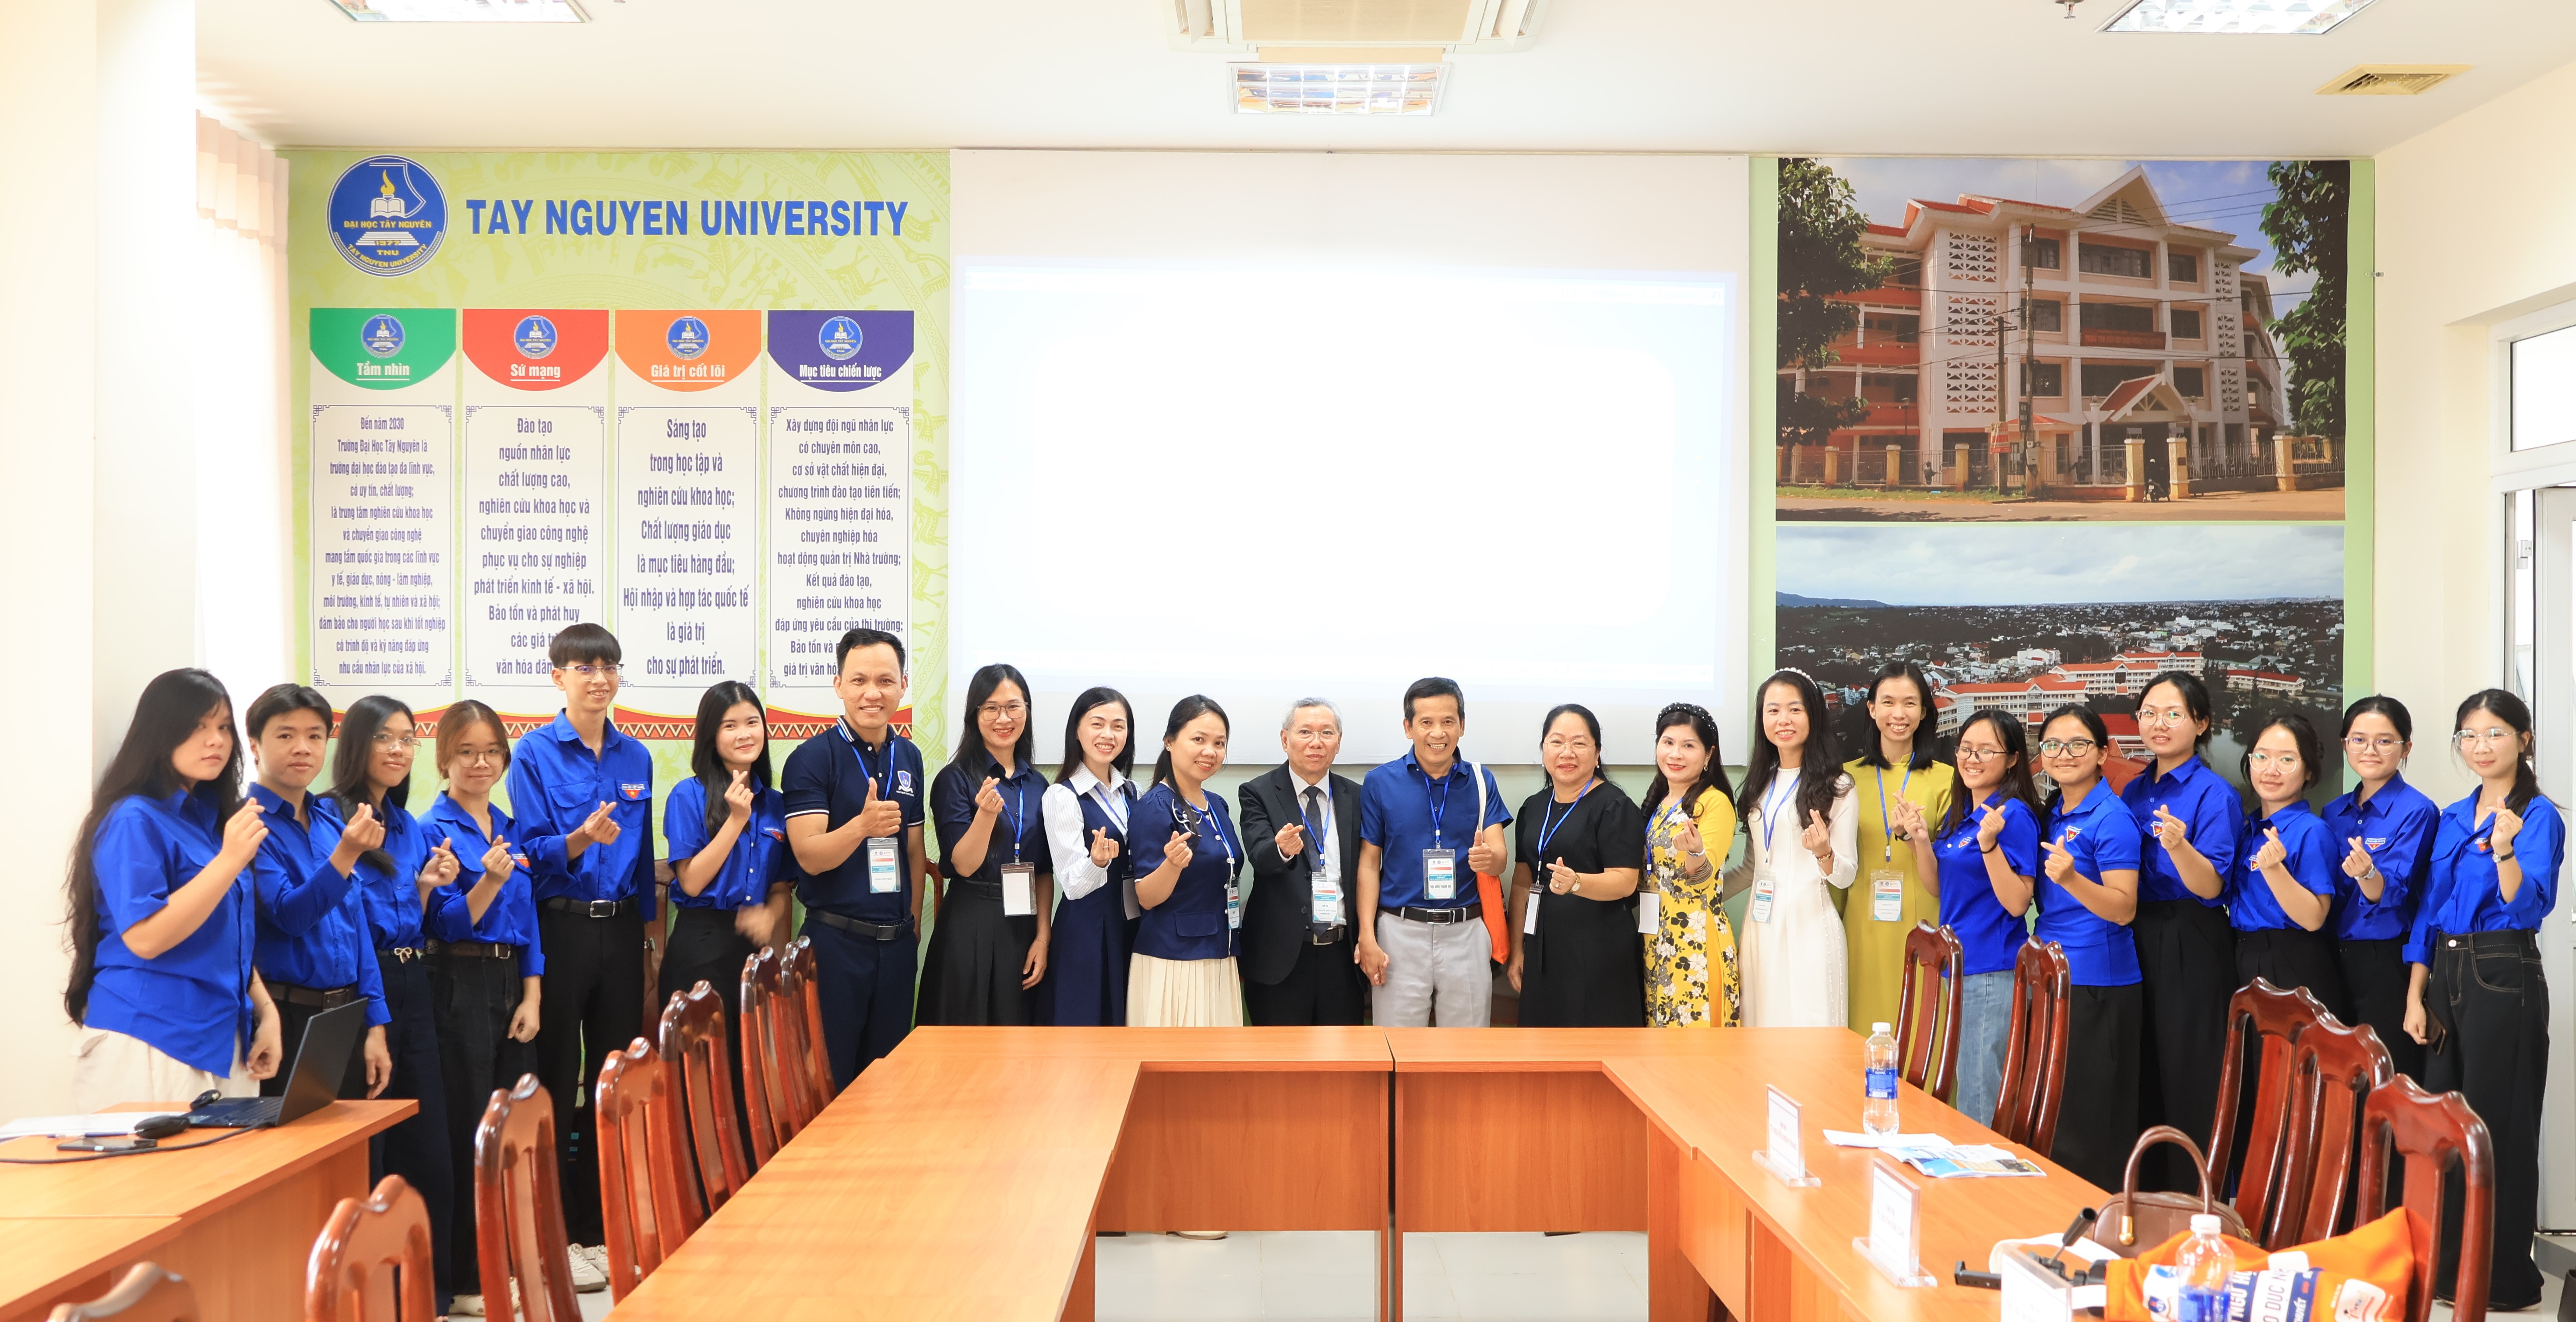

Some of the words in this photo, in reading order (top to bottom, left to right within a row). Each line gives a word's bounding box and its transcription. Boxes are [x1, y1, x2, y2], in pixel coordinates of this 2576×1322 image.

[344, 221, 358, 229] ĐẠI
[360, 221, 377, 229] HỌC
[380, 219, 396, 228] TÂY
[398, 219, 432, 228] NGUYÊN
[467, 200, 532, 234] TAY
[547, 200, 687, 235] NGUYEN
[702, 200, 907, 236] UNIVERSITY
[347, 244, 360, 257] TAY
[359, 255, 388, 267] NGUYEN
[390, 244, 428, 267] UNIVERSITY
[357, 361, 381, 376] Tầm
[384, 362, 410, 376] nhìn
[510, 364, 526, 376] Sứ
[529, 366, 561, 379] mạng
[651, 364, 670, 377] Giá
[673, 365, 685, 380] trị
[689, 362, 708, 377] cốt
[710, 365, 725, 377] lõi
[799, 364, 818, 380] Mục
[820, 364, 836, 377] tiêu
[838, 362, 861, 377] chiến
[863, 365, 882, 380] lược
[360, 415, 372, 429] Đến
[374, 417, 387, 429] năm
[389, 417, 404, 430] 2030
[517, 418, 535, 433] Đào
[538, 419, 552, 436] tạo
[667, 418, 689, 440] Sáng
[692, 420, 706, 442] tạo
[786, 418, 801, 433] Xây
[804, 419, 823, 434] dựng
[826, 418, 838, 434] đội
[841, 419, 856, 433] ngũ
[859, 418, 878, 432] nhân
[881, 419, 893, 434] lực
[499, 443, 527, 461] nguồn
[531, 445, 553, 460] nhân
[556, 445, 570, 463] lực
[799, 441, 808, 454] có
[811, 441, 840, 455] chuyên
[843, 441, 860, 454] môn
[863, 443, 880, 455] cao,
[650, 454, 673, 474] trong
[676, 453, 692, 476] học
[695, 452, 709, 476] tập
[712, 452, 722, 471] và
[793, 465, 802, 475] cơ
[805, 461, 814, 475] sở
[817, 463, 829, 478] vật
[832, 461, 849, 476] chất
[852, 463, 869, 478] hiện
[872, 463, 887, 478] đại,
[499, 468, 519, 486] chất
[522, 471, 547, 490] lượng
[551, 475, 570, 489] cao,
[479, 498, 510, 515] nghiên
[514, 498, 530, 513] cứu
[534, 499, 556, 513] khoa
[559, 499, 576, 517] học
[579, 498, 589, 513] và
[638, 486, 668, 508] nghiên
[671, 486, 687, 505] cứu
[691, 487, 712, 506] khoa
[715, 487, 734, 510] học;
[786, 507, 811, 521] Không
[814, 507, 838, 521] ngừng
[841, 507, 858, 523] hiện
[861, 508, 873, 523] đại
[876, 507, 893, 522] hóa,
[481, 521, 514, 542] chuyển
[517, 525, 537, 542] giao
[540, 525, 562, 542] công
[566, 525, 588, 544] nghệ
[641, 517, 662, 539] Chất
[665, 520, 689, 543] lượng
[692, 520, 711, 541] giáo
[715, 520, 730, 544] dục
[801, 529, 830, 544] chuyên
[833, 530, 860, 545] nghiệp
[863, 530, 877, 542] hóa
[483, 552, 505, 570] phục
[508, 555, 518, 570] vụ
[522, 552, 538, 567] cho
[542, 553, 553, 570] sự
[555, 552, 586, 571] nghiệp
[638, 554, 645, 573] là
[648, 558, 668, 577] mục
[671, 554, 687, 573] tiêu
[691, 554, 712, 575] hàng
[716, 551, 734, 575] đầu;
[474, 578, 494, 595] phát
[497, 575, 518, 594] triển
[522, 579, 541, 594] kinh
[545, 576, 554, 594] tế
[563, 579, 574, 594] xã
[577, 579, 594, 598] hội.
[624, 587, 638, 611] Hội
[641, 587, 663, 611] nhập
[666, 587, 676, 607] và
[679, 588, 695, 611] hợp
[698, 588, 712, 607] tác
[715, 585, 737, 609] quốc
[740, 584, 749, 607] tế
[489, 604, 506, 620] Bảo
[509, 603, 523, 620] tồn
[527, 605, 537, 620] và
[540, 605, 560, 622] phát
[564, 606, 580, 622] huy
[511, 632, 527, 647] các
[531, 632, 545, 649] giá
[667, 621, 675, 640] là
[678, 622, 692, 643] giá
[695, 622, 704, 645] trị
[496, 659, 512, 674] văn
[516, 659, 532, 674] hóa
[536, 658, 552, 674] dân
[647, 656, 663, 675] cho
[666, 657, 677, 679] sự
[680, 655, 699, 677] phát
[701, 651, 725, 675] triển.
